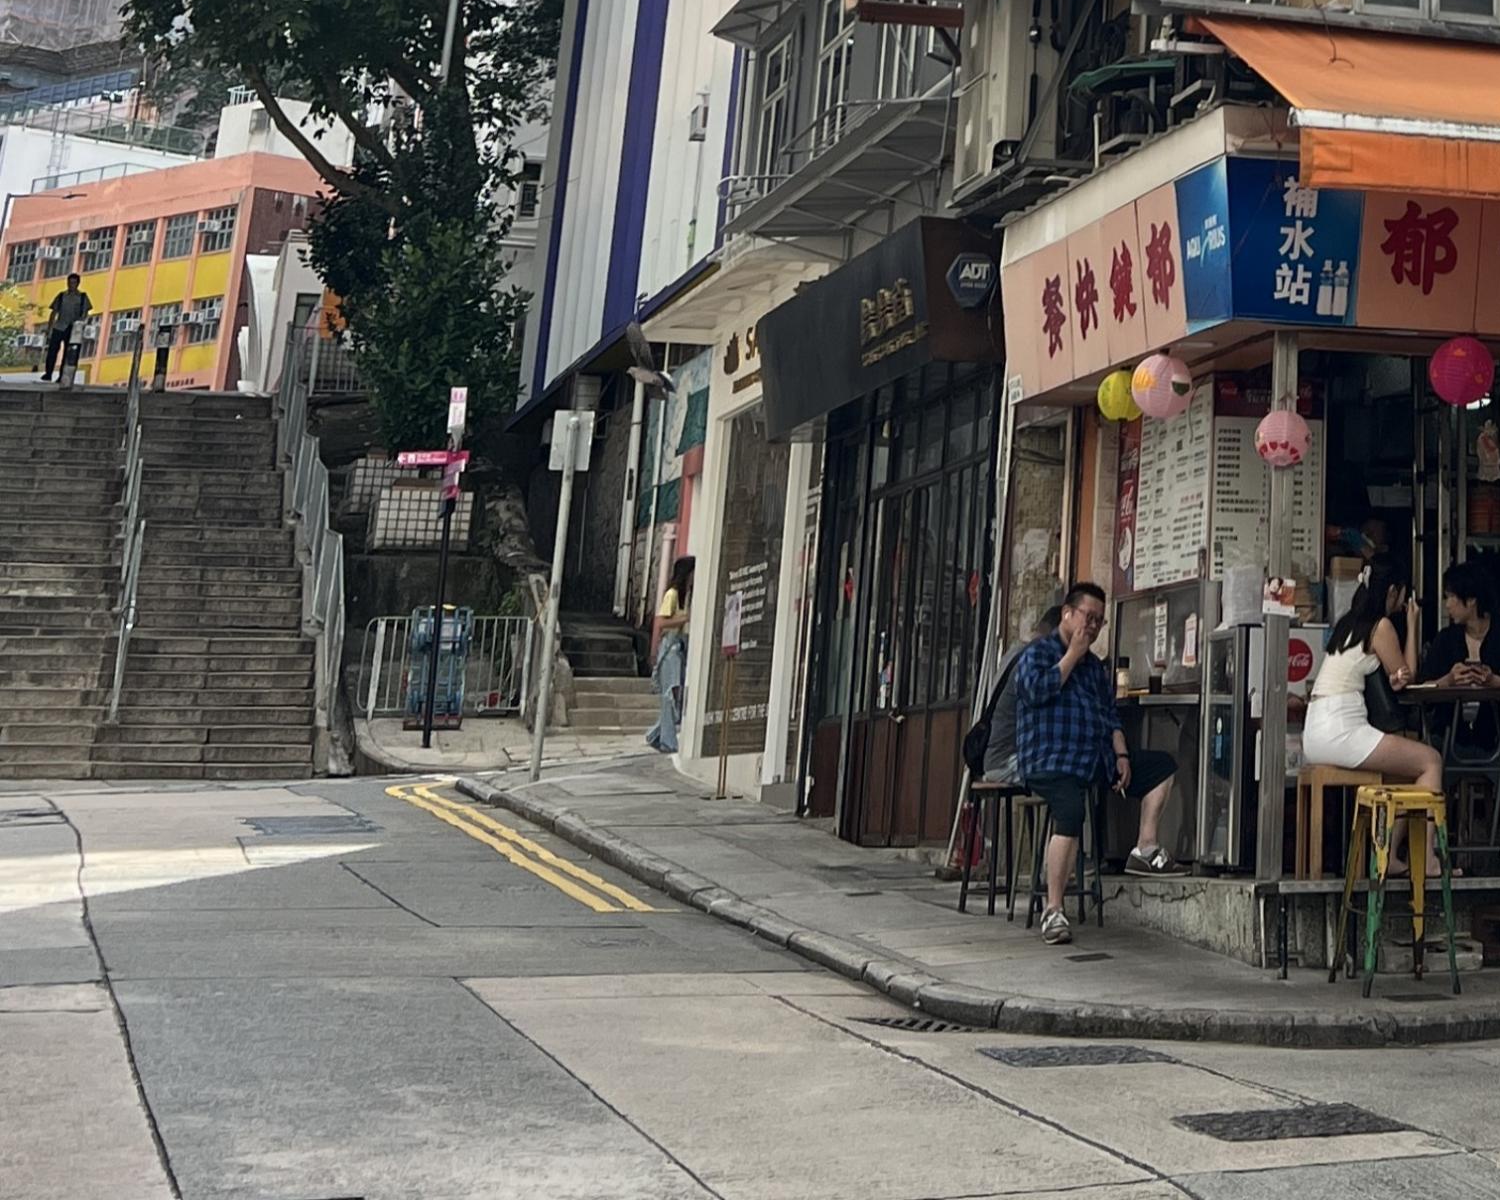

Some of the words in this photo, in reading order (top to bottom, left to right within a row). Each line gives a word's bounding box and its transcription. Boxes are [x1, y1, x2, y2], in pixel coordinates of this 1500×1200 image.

[958, 262, 991, 281] ADT
[1274, 175, 1319, 306] 補水站
